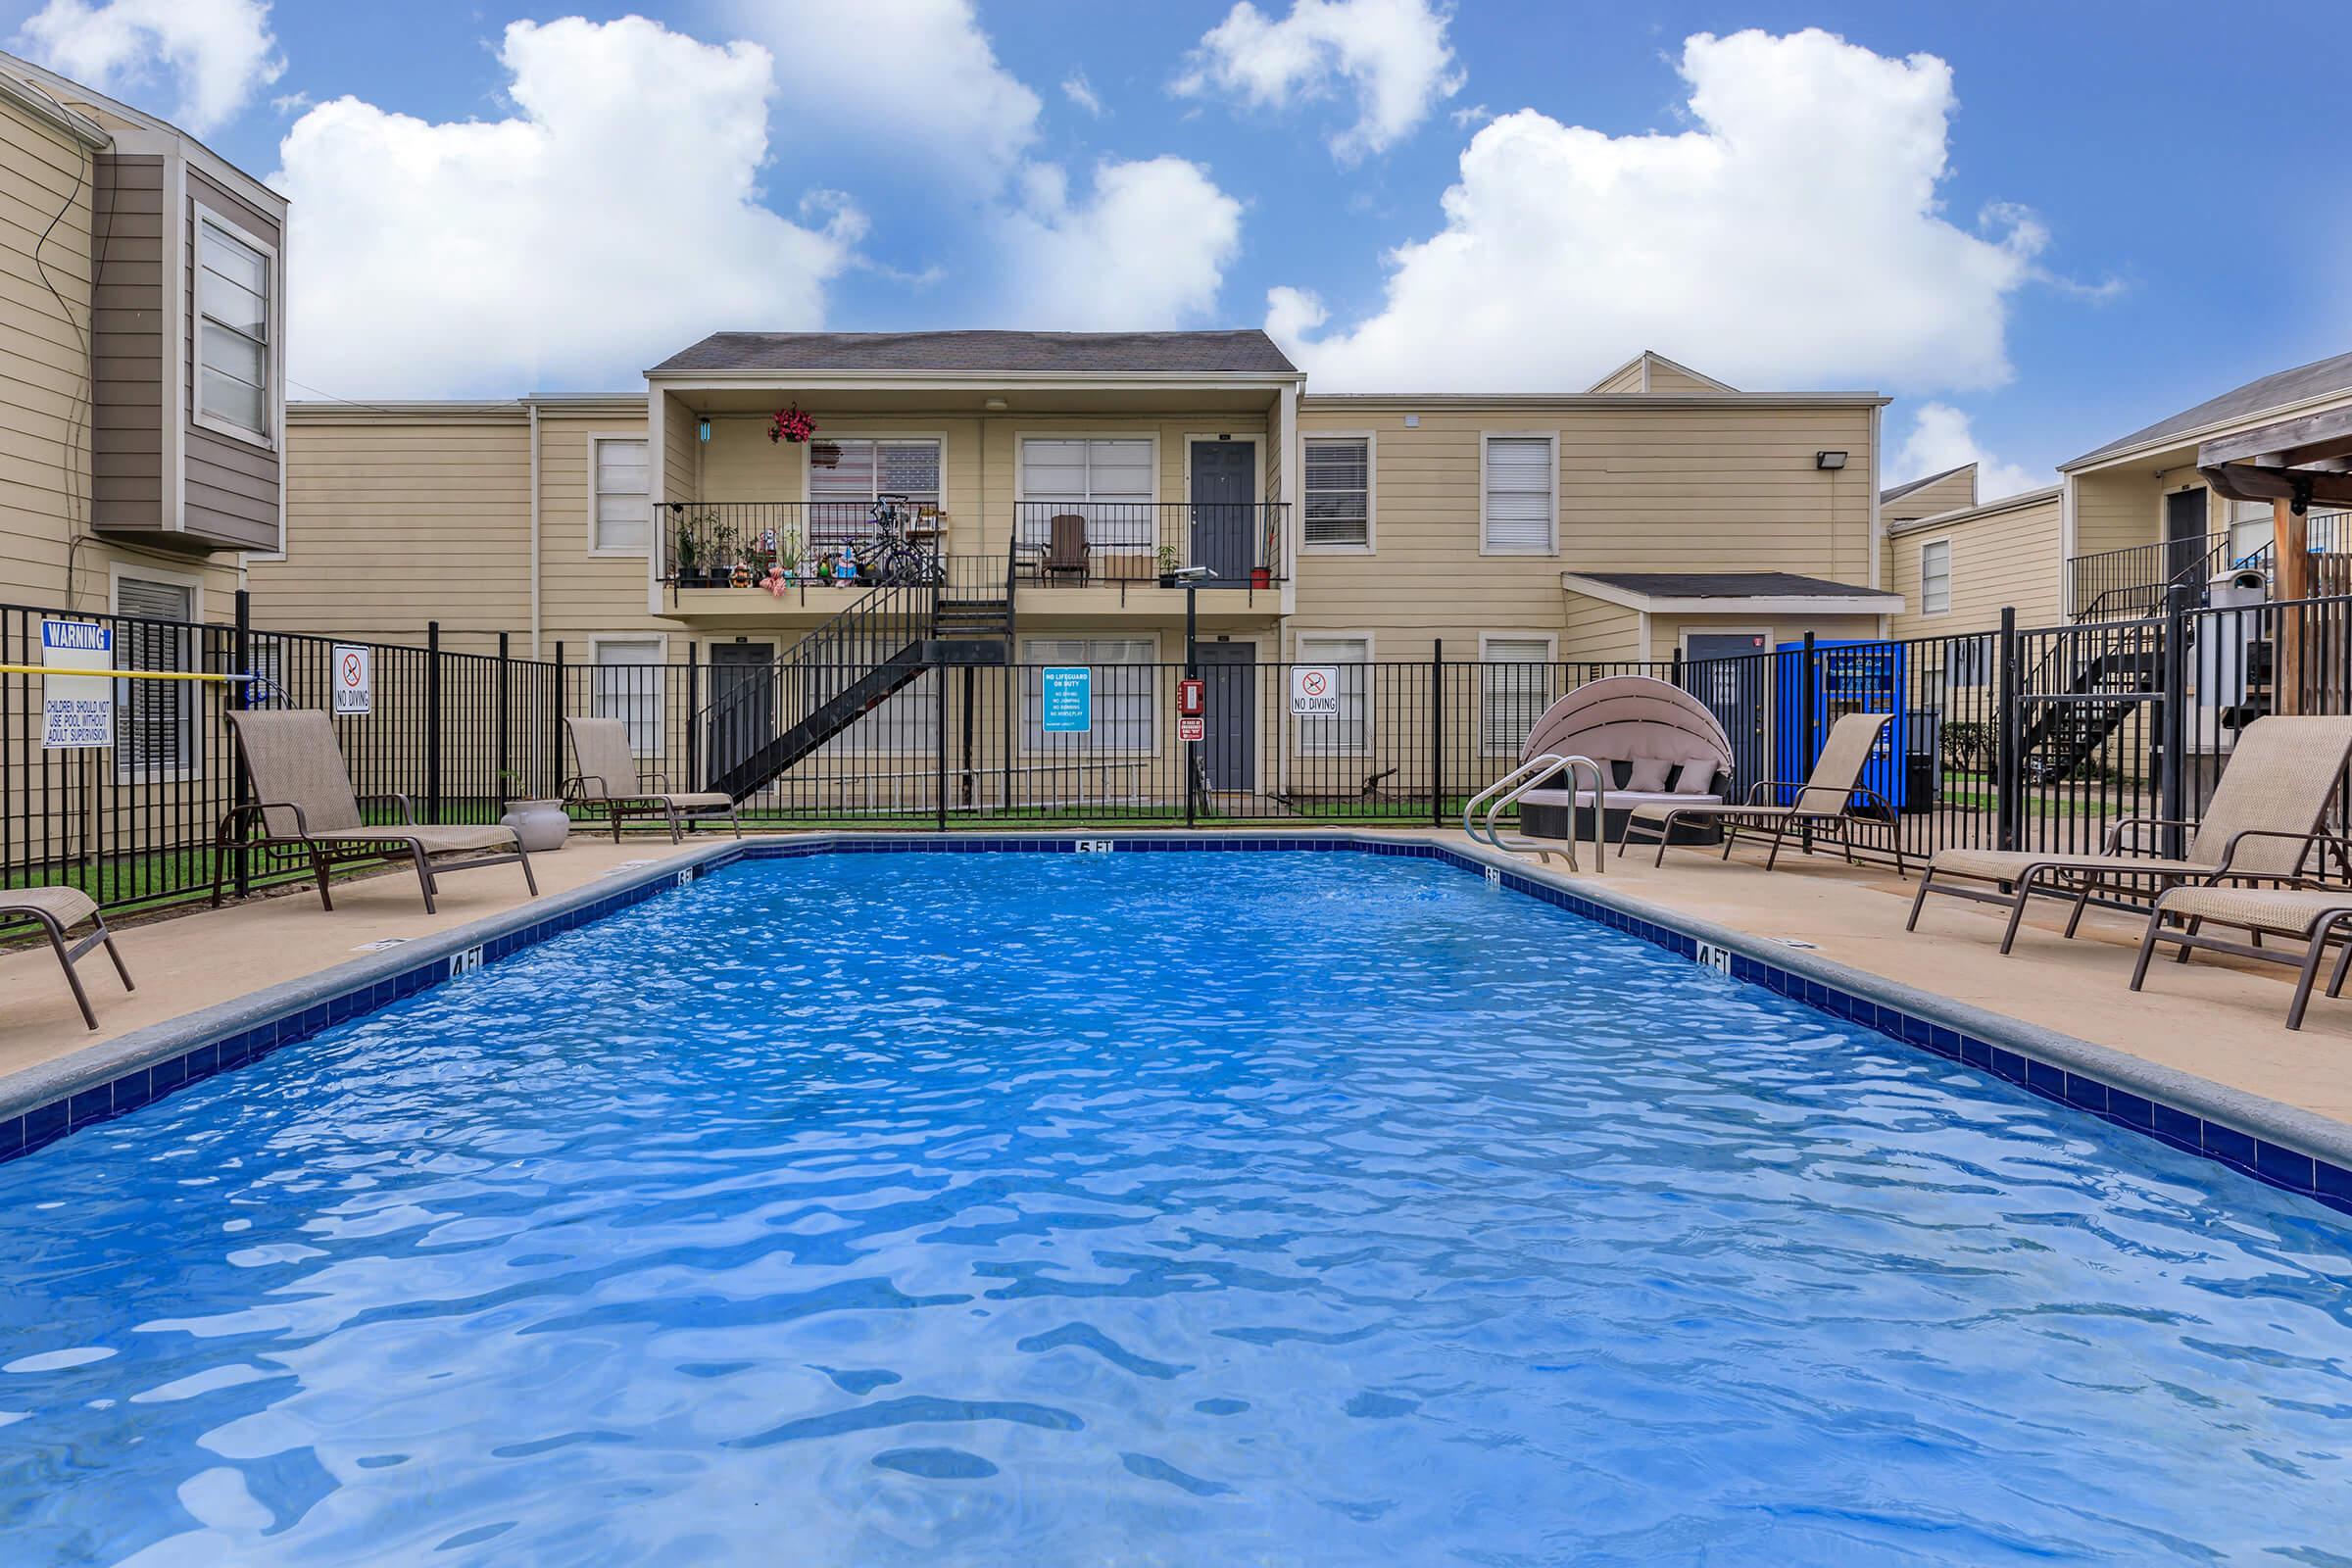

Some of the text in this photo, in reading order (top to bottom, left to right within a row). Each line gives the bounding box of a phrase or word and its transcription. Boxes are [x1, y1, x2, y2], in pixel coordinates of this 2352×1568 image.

[47, 622, 105, 650] WARNING
[337, 690, 368, 707] NO DIVING
[1295, 697, 1335, 710] NO DIVING
[47, 700, 110, 713] CHILDREN SHOULD NOT
[50, 714, 107, 727] USE POOL WITHOUT
[48, 728, 107, 742] ADULT SUPERVISION
[1080, 841, 1111, 852] 5 FT
[452, 946, 481, 976] 4 FT
[1699, 945, 1729, 974] 4 FT
